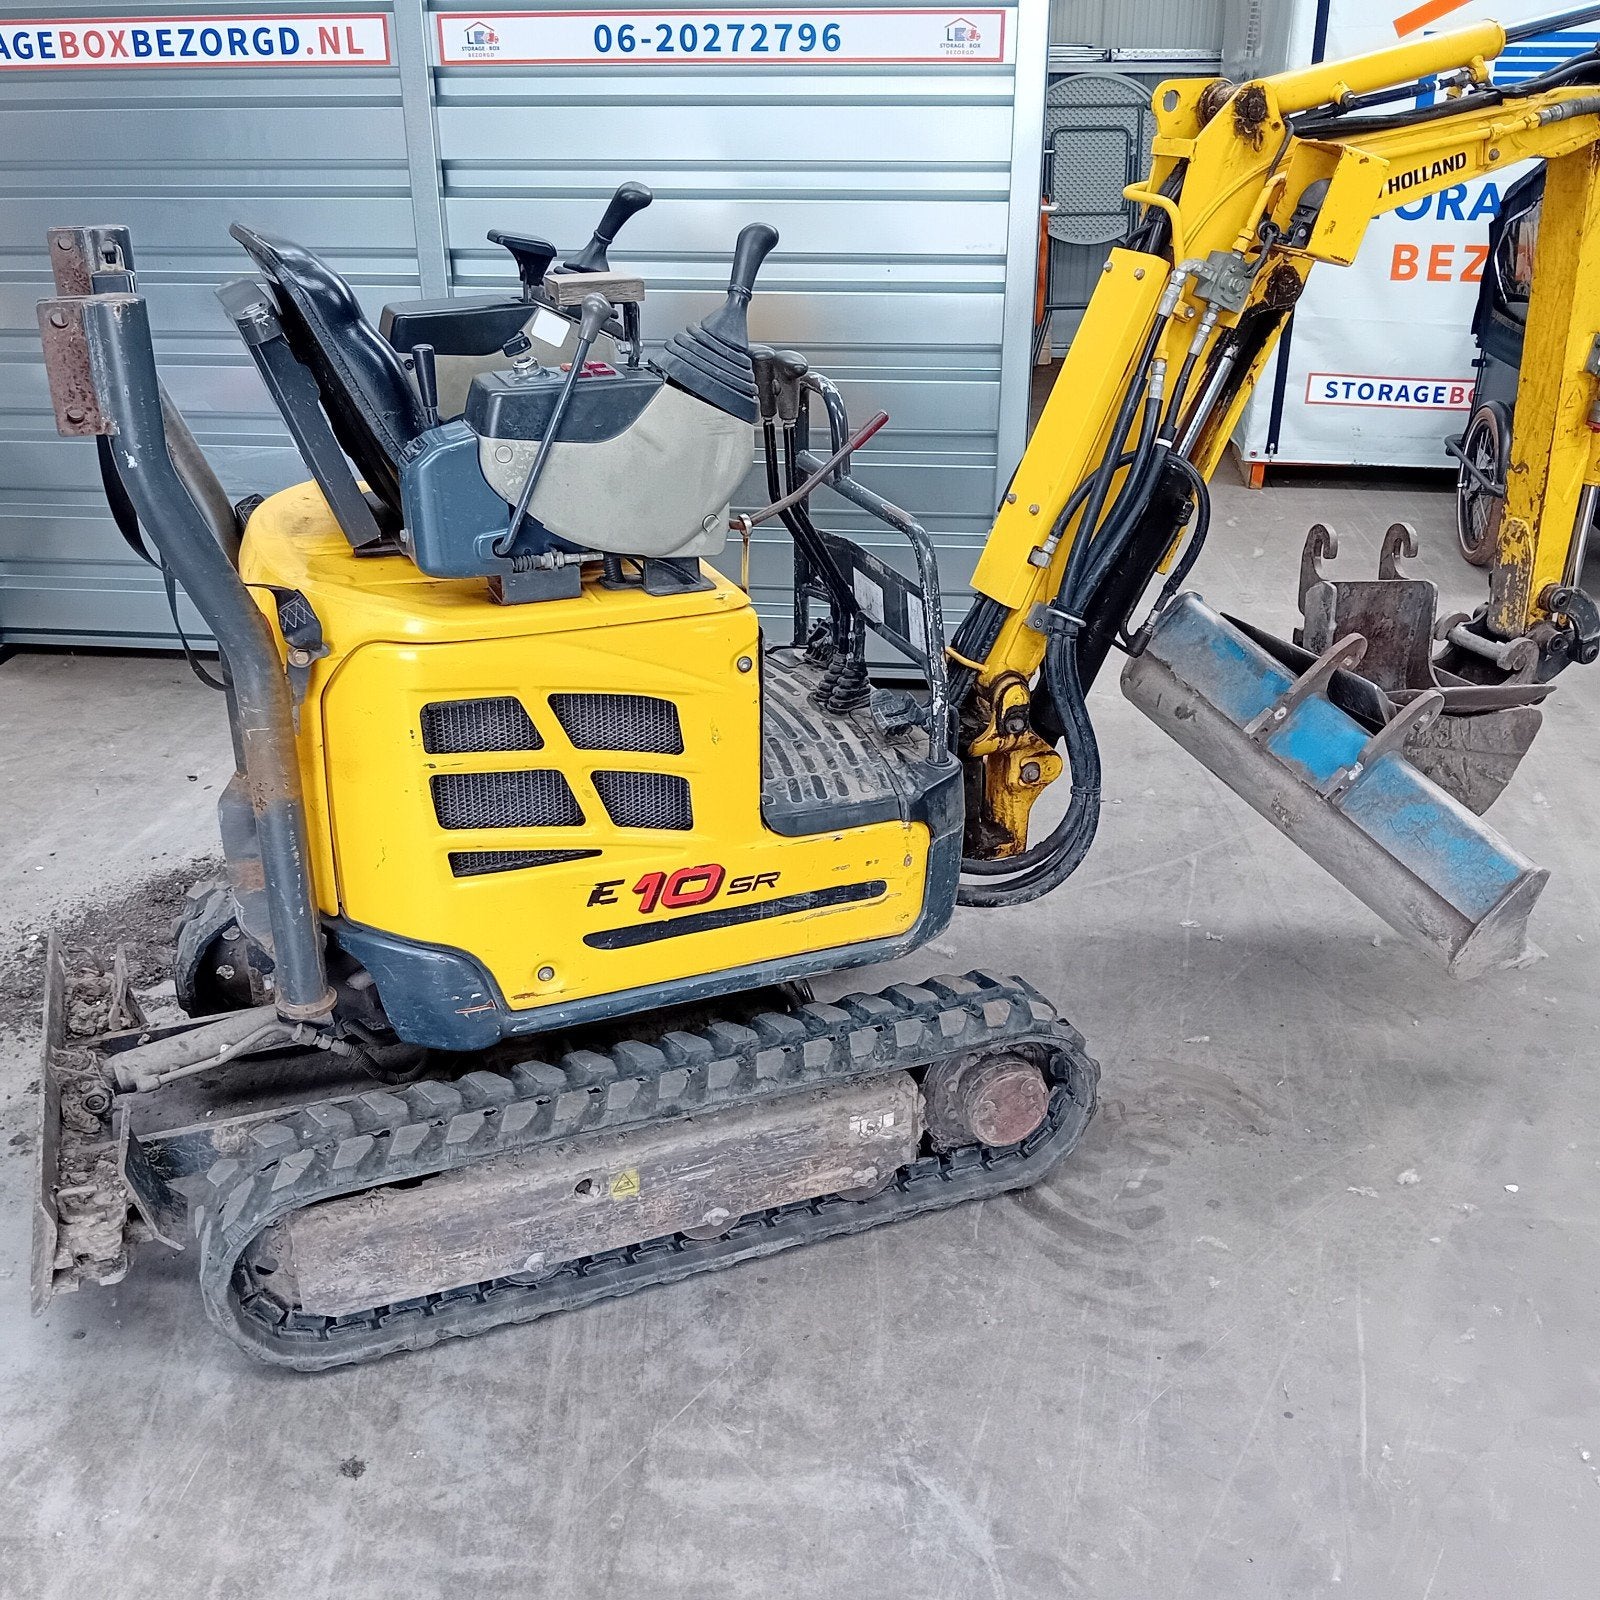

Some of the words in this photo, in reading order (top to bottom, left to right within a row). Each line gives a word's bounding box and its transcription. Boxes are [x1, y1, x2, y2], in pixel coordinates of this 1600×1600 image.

[593, 22, 842, 53] 06-20272796
[1387, 151, 1467, 195] HOLLAND
[1389, 243, 1490, 283] BEZ
